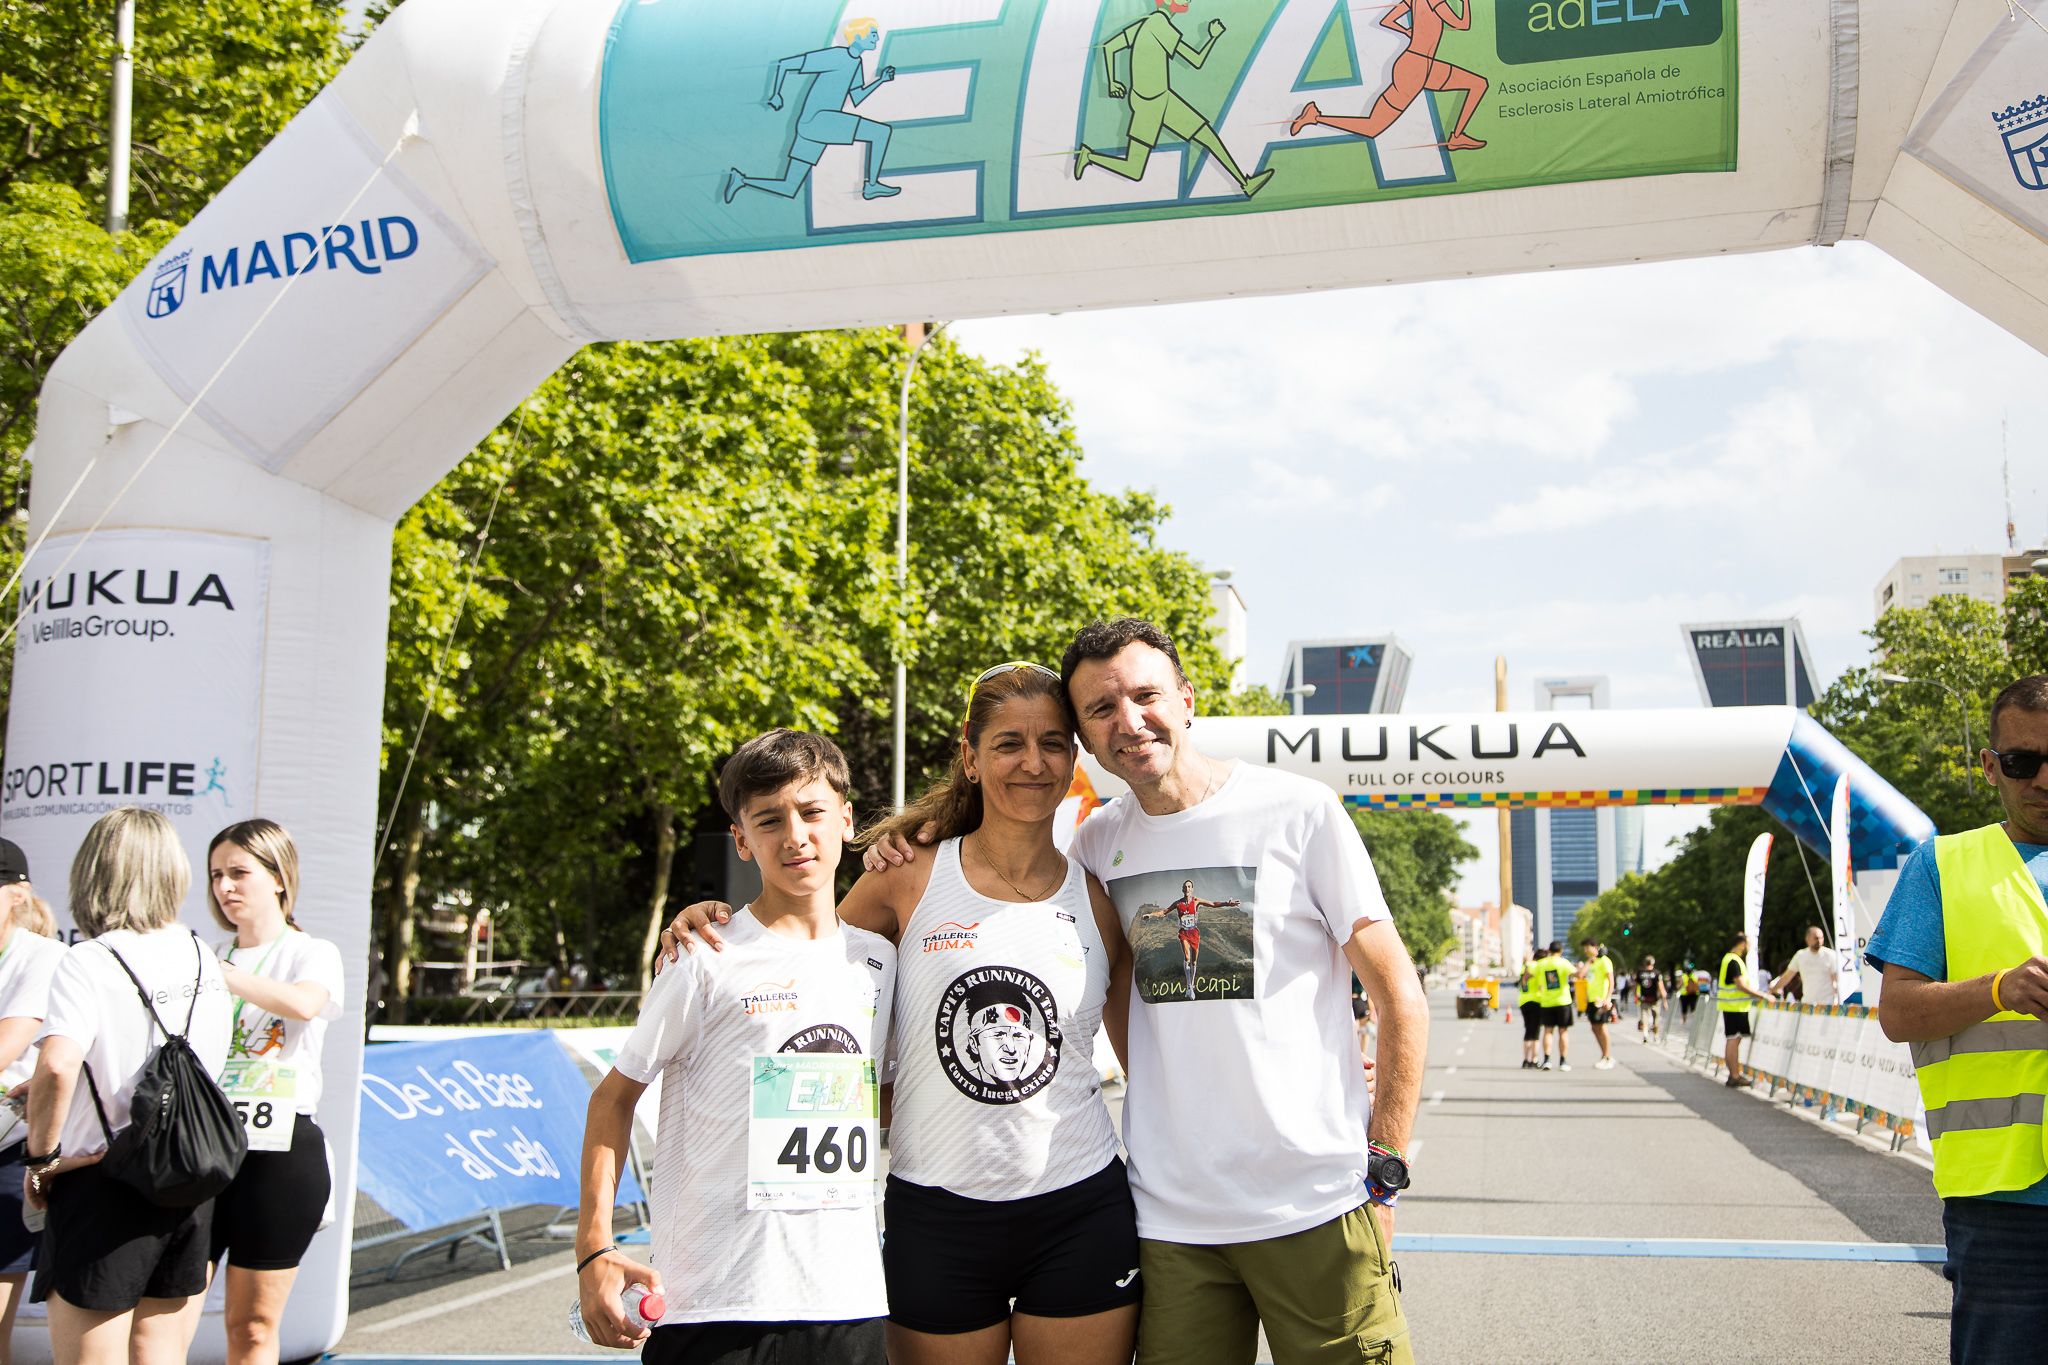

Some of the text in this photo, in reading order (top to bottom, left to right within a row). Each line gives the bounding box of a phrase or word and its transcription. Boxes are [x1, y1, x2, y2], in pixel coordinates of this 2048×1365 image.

[1498, 64, 1681, 95] Asociación Española de
[806, 0, 1457, 235] ELA
[1498, 85, 1725, 118] Esclerosis Lateral Amiotrófica
[201, 215, 418, 294] MADRID
[22, 569, 235, 614] MUKUA
[1697, 631, 1779, 649] REALIA
[1267, 722, 1586, 763] MUKUA
[1348, 771, 1505, 786] FULL OF COLOURS
[922, 932, 978, 948] TALLERES
[923, 940, 975, 953] JUMA
[740, 992, 798, 1009] TALLERES
[940, 969, 1060, 1039] CAPI'S RUNNING TEAM
[1152, 982, 1187, 997] con
[743, 1002, 799, 1017] JUMA
[793, 1027, 857, 1054] RUNNING
[360, 1060, 543, 1120] De la Base
[786, 1071, 865, 1112] ELA
[981, 1086, 1020, 1101] luego
[1020, 1063, 1055, 1095] existo
[444, 1132, 498, 1181] al
[777, 1126, 867, 1174] 460
